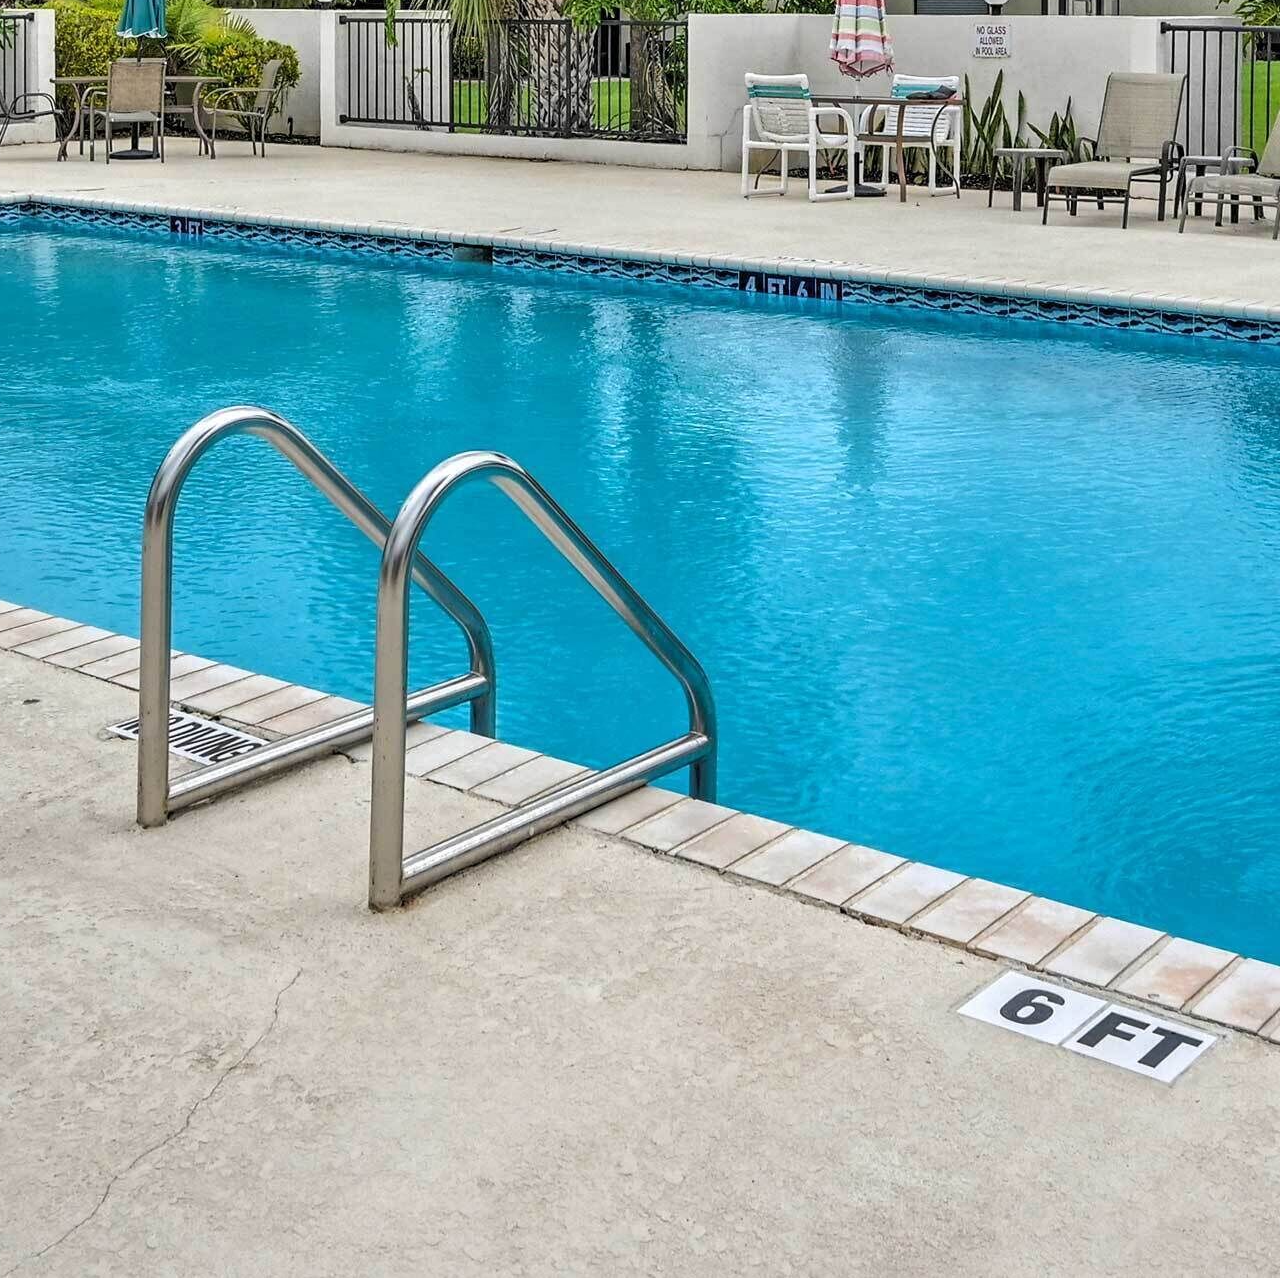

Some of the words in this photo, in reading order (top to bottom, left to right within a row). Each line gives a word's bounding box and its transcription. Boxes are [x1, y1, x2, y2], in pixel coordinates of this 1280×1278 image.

[976, 26, 985, 35] NO
[987, 26, 1007, 35] GLASS
[979, 36, 1005, 45] ALLOWED
[981, 47, 994, 56] POOL
[995, 47, 1008, 56] AREA
[745, 276, 757, 293] 4
[767, 278, 786, 296] FT
[796, 281, 809, 299] 6
[820, 282, 838, 301] IN
[168, 721, 263, 763] DIVING
[999, 988, 1066, 1026] 6
[1076, 1011, 1204, 1070] FT
